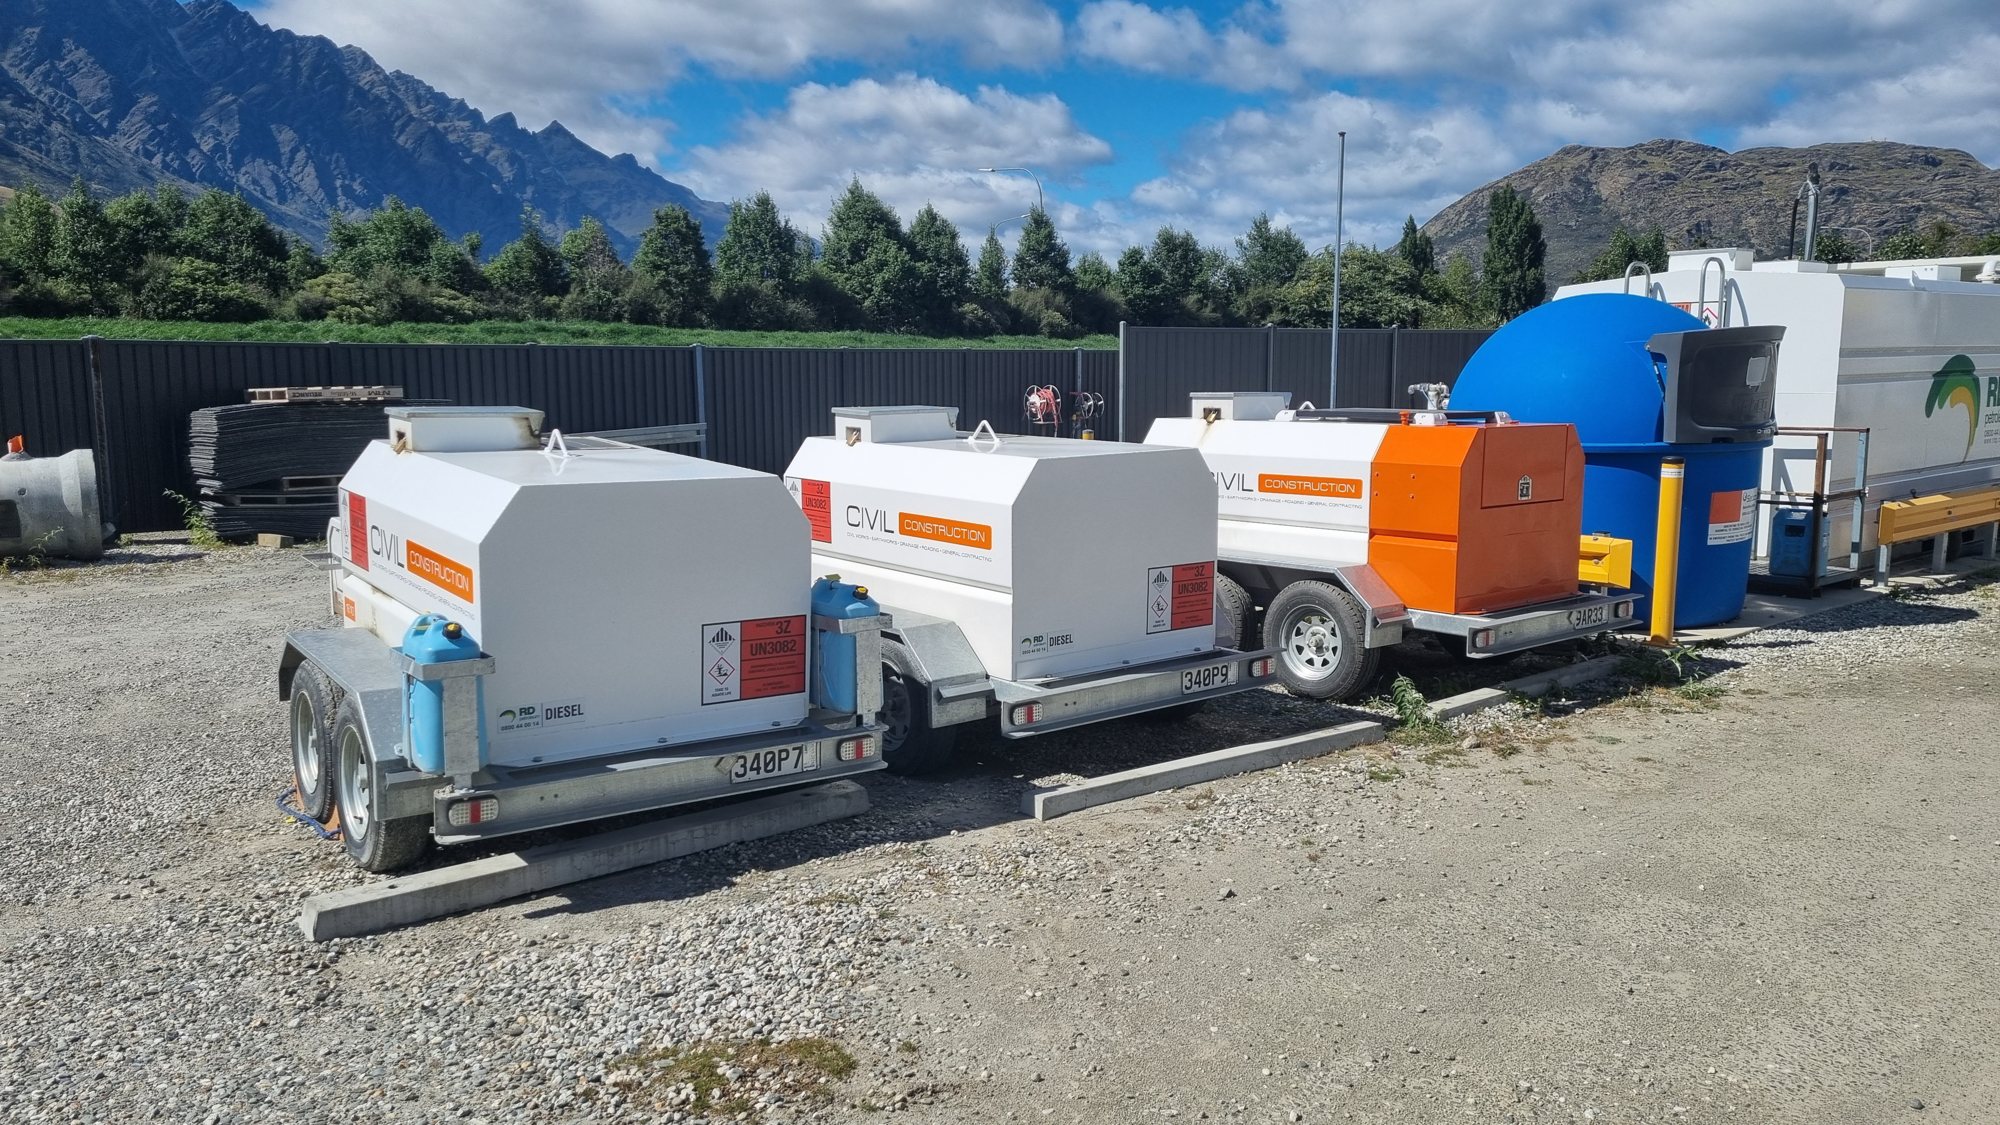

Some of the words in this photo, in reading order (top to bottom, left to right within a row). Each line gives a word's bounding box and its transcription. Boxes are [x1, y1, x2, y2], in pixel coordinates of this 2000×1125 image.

[1211, 471, 1254, 492] IVIL
[1264, 479, 1356, 493] CONSTRUCTION
[846, 505, 894, 534] CIVIL
[904, 519, 986, 543] CONSTRUCTION
[370, 524, 405, 569] CIVIL
[409, 550, 469, 592] CONSTRUCTION
[1194, 565, 1206, 577] 3Z
[1177, 581, 1209, 595] UN3082
[775, 620, 792, 635] 3Z
[749, 639, 798, 657] UN3082
[1033, 635, 1044, 643] RD
[1049, 634, 1074, 647] DIESEL
[1184, 664, 1229, 690] 340P9
[519, 706, 536, 717] RD
[545, 703, 584, 721] DIESEL
[734, 745, 804, 778] 340P7
